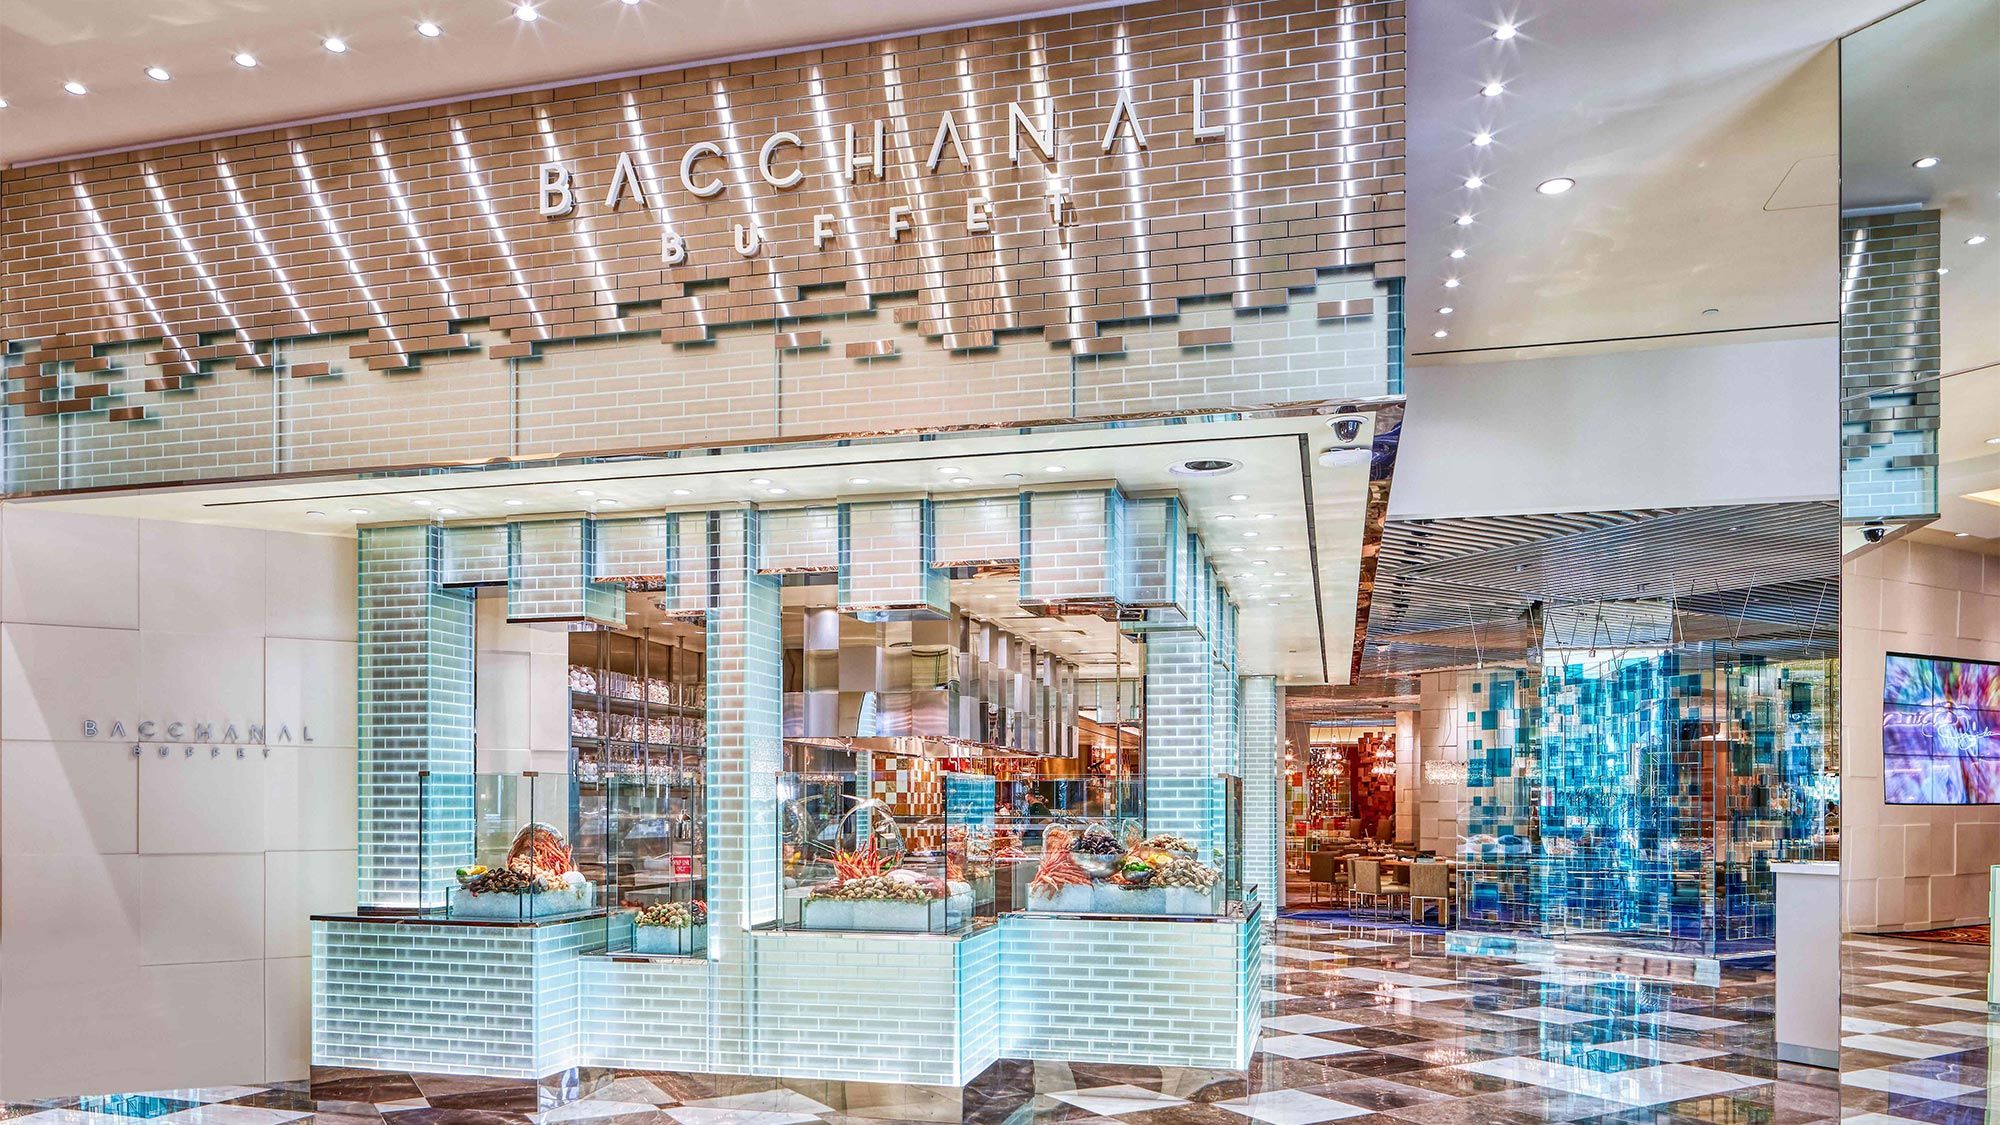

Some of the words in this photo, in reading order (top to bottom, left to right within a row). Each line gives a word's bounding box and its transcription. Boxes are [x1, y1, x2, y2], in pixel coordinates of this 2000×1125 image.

[539, 78, 1226, 217] BACCHANAL
[660, 188, 1072, 266] BUFFET
[83, 719, 314, 743] BACCHANAL
[132, 745, 271, 759] BUFFET
